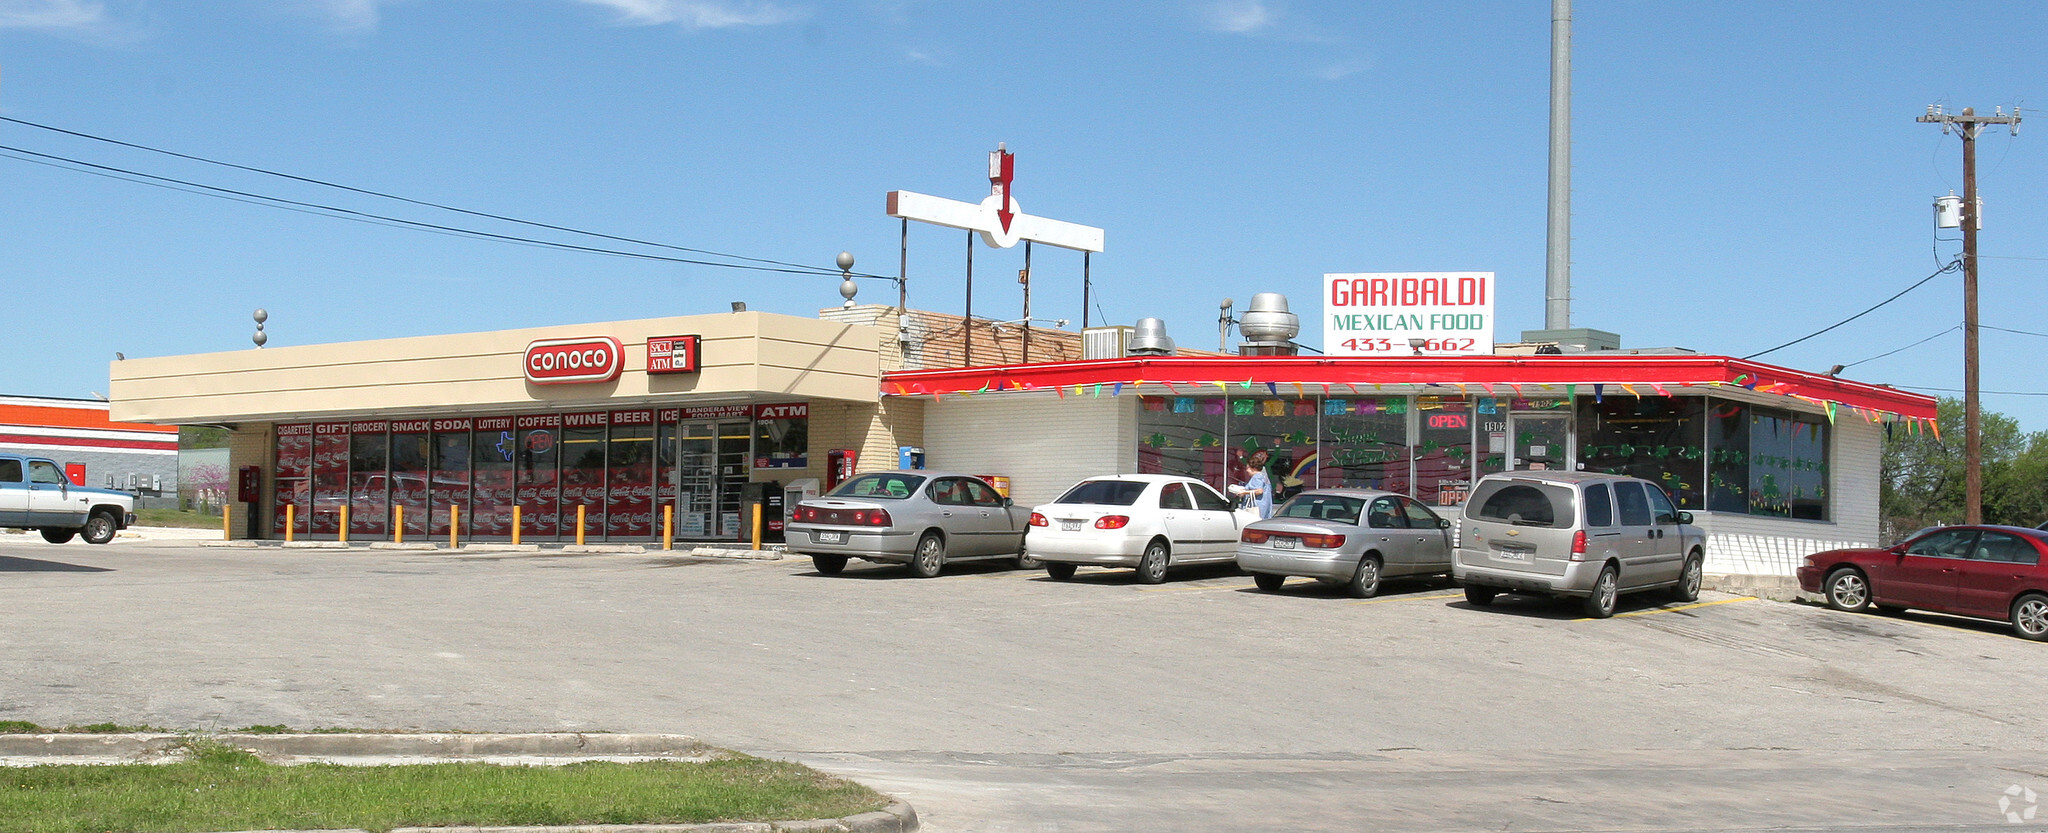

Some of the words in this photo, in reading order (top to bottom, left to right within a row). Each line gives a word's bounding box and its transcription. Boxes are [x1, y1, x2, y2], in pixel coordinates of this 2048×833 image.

[1332, 277, 1486, 306] GARIBALDI
[1333, 313, 1423, 331] MEXICAN
[1430, 313, 1483, 331] FOOD
[651, 343, 671, 352] SACU
[1341, 338, 1475, 351] 433-662
[650, 358, 671, 370] ATM
[661, 410, 678, 421] ICE
[686, 406, 725, 414] BANDERA
[761, 405, 807, 418] ATM
[518, 416, 560, 427] COFFEE
[565, 413, 607, 425] WINE
[614, 411, 650, 423] BEER
[1428, 415, 1467, 428] OPEN
[316, 424, 349, 433] GIFT
[352, 422, 387, 432] GROCERY
[392, 421, 429, 431] SNACK
[434, 420, 471, 430] SODA
[478, 419, 511, 429] LOTTERY
[1486, 422, 1506, 431] 1902
[277, 425, 312, 435] CIGARETTES
[525, 434, 554, 449] OPEN
